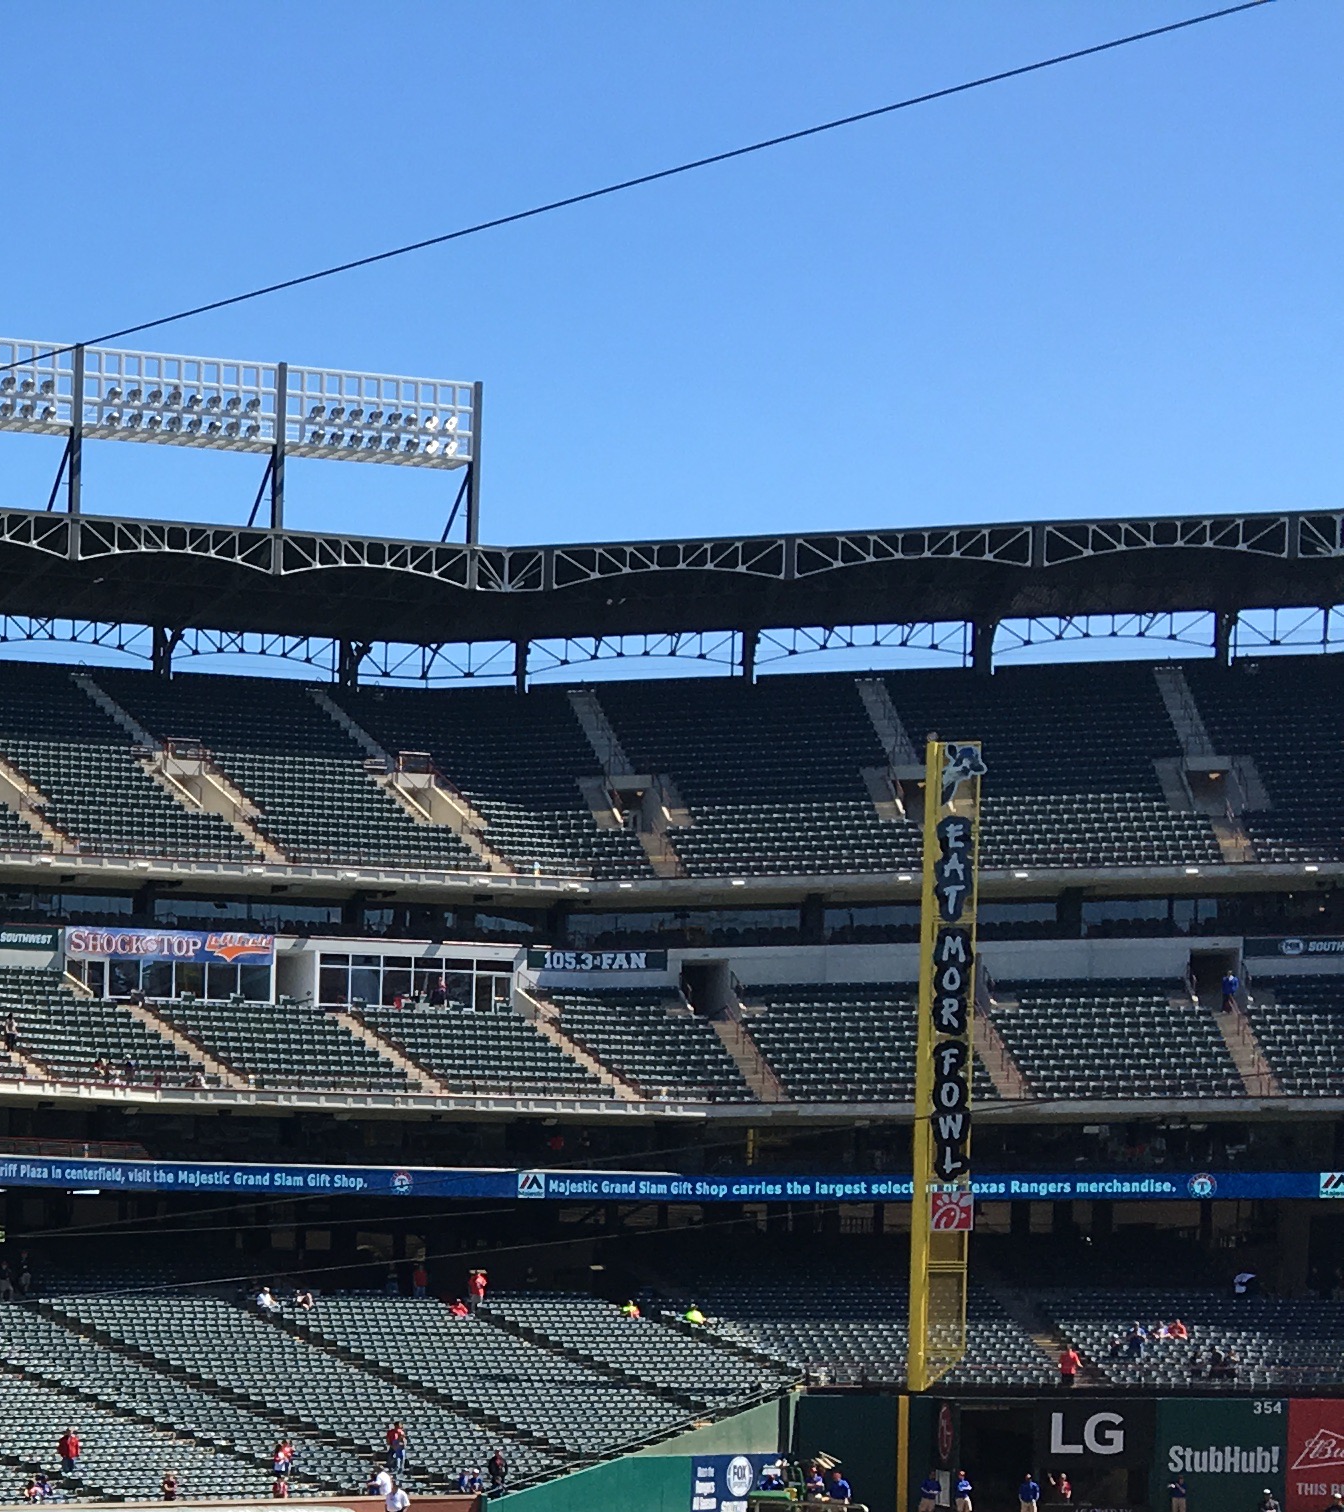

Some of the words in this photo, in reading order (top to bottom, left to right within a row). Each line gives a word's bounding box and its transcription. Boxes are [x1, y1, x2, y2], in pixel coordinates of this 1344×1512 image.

[943, 822, 967, 915] EAT
[0, 932, 53, 945] SOUTHWEST
[70, 930, 147, 955] SHOCK
[157, 935, 203, 957] TOP
[544, 952, 593, 970] 105.3
[600, 952, 647, 969] FAN
[941, 935, 967, 1030] MOR
[938, 1048, 963, 1174] FOWL
[20, 1165, 49, 1179] Plaza
[51, 1166, 62, 1179] in
[64, 1167, 126, 1184] centerfield,
[128, 1169, 152, 1183] visit
[153, 1170, 174, 1184] the
[178, 1170, 231, 1187] Majestic
[233, 1171, 270, 1187] Grand
[274, 1173, 304, 1187] Slam
[307, 1173, 330, 1188] Gift
[333, 1174, 368, 1190] Shop.
[549, 1179, 599, 1196] Majestic
[601, 1181, 636, 1194] Grand
[639, 1181, 668, 1195] Slam
[670, 1181, 694, 1195] Gift
[695, 1182, 728, 1198] Shop
[732, 1181, 782, 1195] carries
[786, 1181, 811, 1195] the
[815, 1181, 867, 1198] largest
[1010, 1180, 1071, 1197] Rangers
[1075, 1179, 1177, 1194] merchandise.
[1253, 1401, 1283, 1415] 354
[1050, 1412, 1125, 1455] LG
[1168, 1445, 1280, 1474] StubHub!
[732, 1464, 747, 1481] FOX
[1295, 1482, 1328, 1496] THIS
